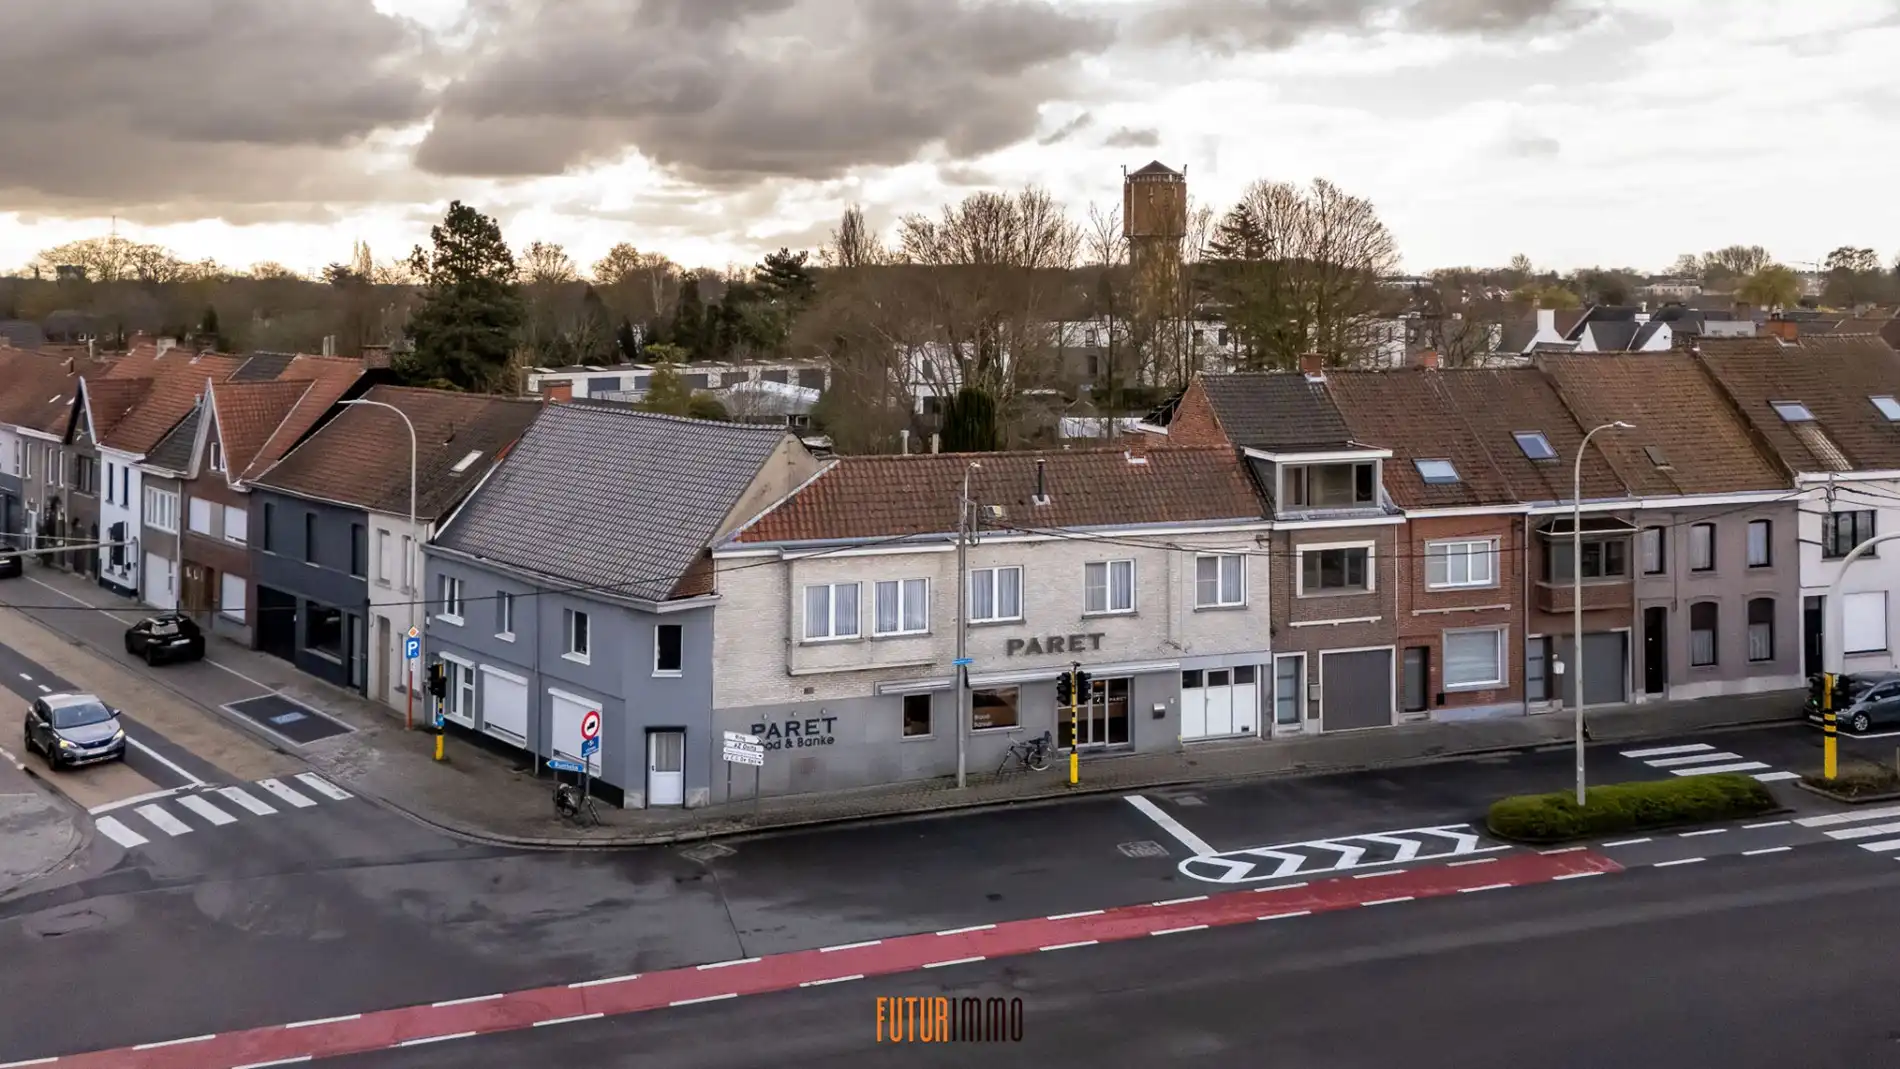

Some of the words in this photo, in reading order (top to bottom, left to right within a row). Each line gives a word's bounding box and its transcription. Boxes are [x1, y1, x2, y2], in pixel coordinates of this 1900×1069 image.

[408, 641, 418, 656] P
[1007, 633, 1105, 656] PARET
[751, 717, 838, 740] PARET
[784, 738, 794, 749] &
